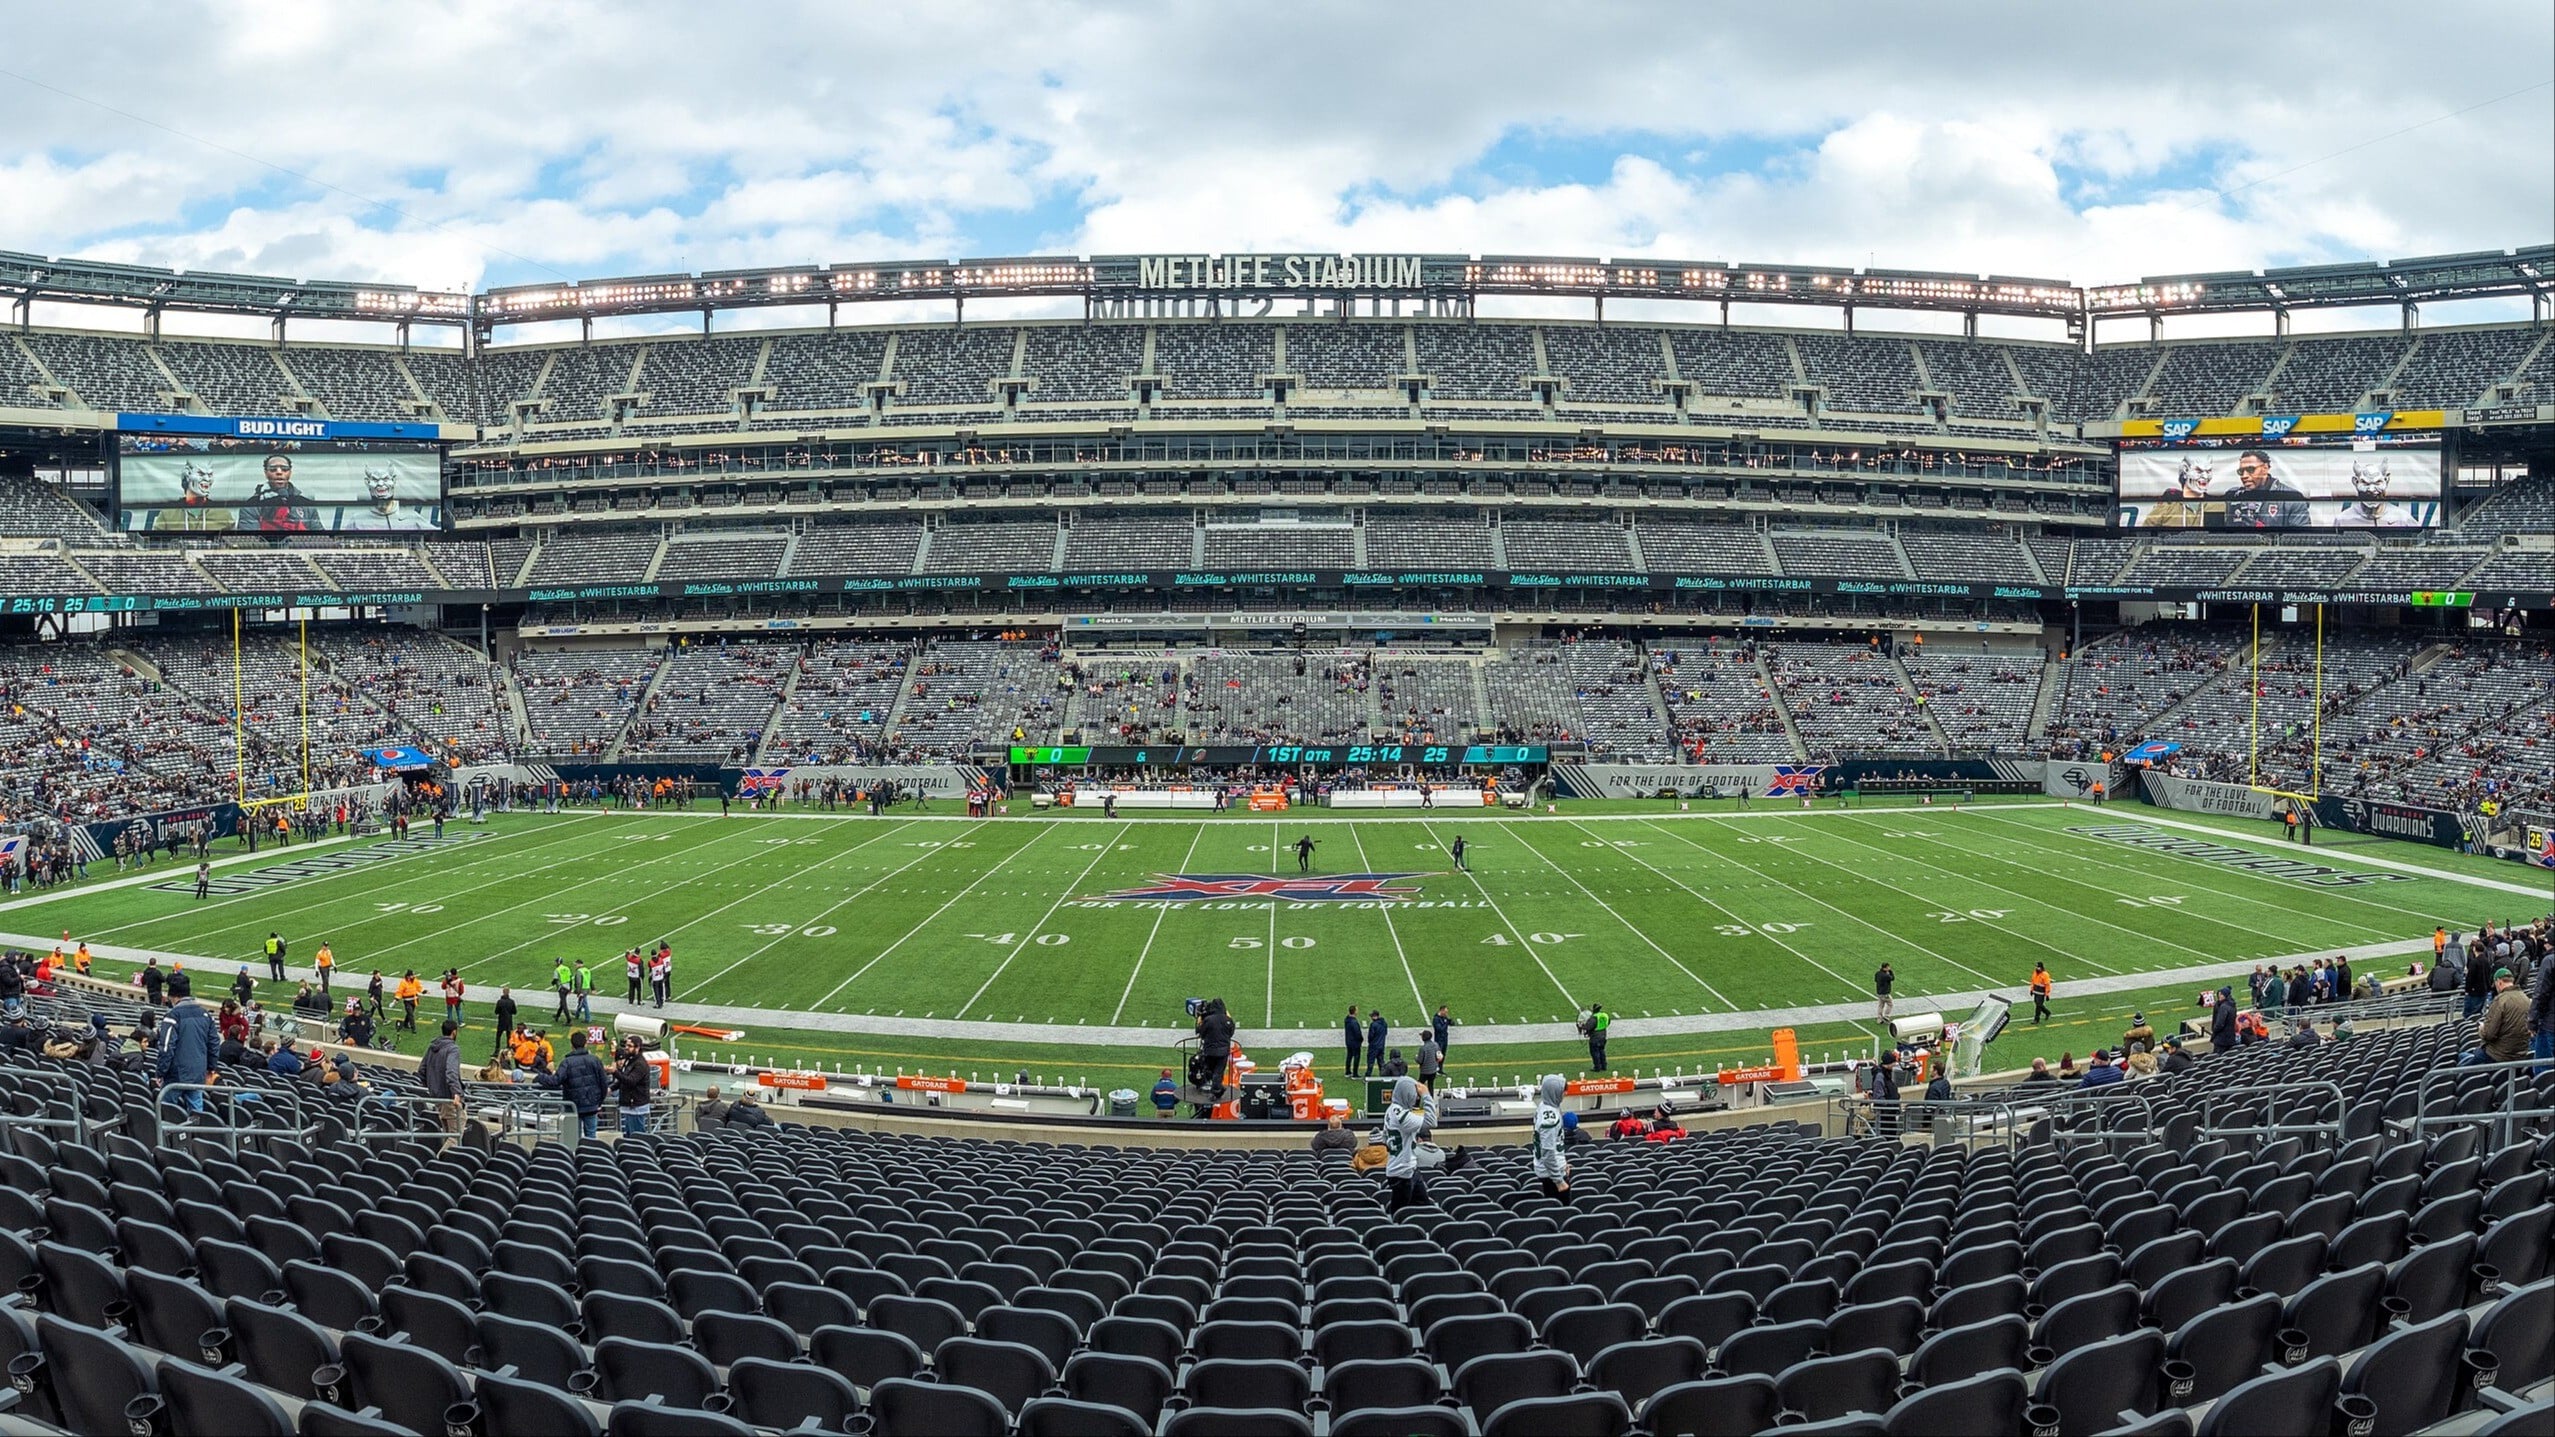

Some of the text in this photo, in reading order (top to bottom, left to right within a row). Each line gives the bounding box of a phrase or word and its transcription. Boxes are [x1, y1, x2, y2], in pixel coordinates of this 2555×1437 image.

[1139, 256, 1422, 288] METLIFE STADIUM
[240, 421, 325, 436] BUD LIGHT
[2163, 423, 2191, 437] SAP
[2262, 420, 2291, 435] SAP
[2355, 417, 2384, 431] SAP
[898, 577, 981, 588] @WHITESTARBAR
[1063, 574, 1148, 585] @WHITESTARBAR
[1230, 573, 1316, 584] @WHITESTARBAR
[1398, 573, 1484, 584] @WHITESTARBAR
[1565, 574, 1648, 586] @WHITESTARBAR
[1729, 578, 1812, 590] @WHITESTARBAR
[580, 586, 659, 598] @WHITESTARBAR
[737, 580, 818, 592] @WHITESTARBAR
[1890, 584, 1970, 595] @WHITESTARBAR
[206, 595, 283, 607] @WHITESTARBAR
[346, 593, 422, 604] @WHITESTARBAR
[2196, 590, 2274, 601] @WHITESTARBAR
[2333, 593, 2411, 604] @WHITESTARBAR
[2445, 592, 2455, 605] 0
[12, 598, 55, 612] 25:16
[64, 598, 83, 611] 25
[125, 597, 136, 609] 0
[2508, 597, 2515, 607] &
[1230, 616, 1327, 624] METLIFE STADIUM
[1050, 748, 1062, 763] 0
[1136, 752, 1147, 762] &
[1268, 747, 1331, 762] 1ST QTR
[1347, 747, 1402, 762] 25:14
[1423, 747, 1448, 762] 25
[1516, 747, 1528, 761] 0
[1610, 776, 1759, 786] FOR THE LOVE OF FOOTBALL
[2185, 785, 2247, 800] FOR THE LOVE
[294, 799, 306, 810] 25
[308, 793, 324, 808] FOR
[2202, 798, 2261, 814] OF FOOTBALL
[2371, 807, 2434, 838] GUARDIANS
[2530, 832, 2542, 847] 25
[1062, 901, 1116, 909] FOR
[1295, 901, 1323, 909] OF
[1339, 901, 1491, 909] FOOTBALL
[547, 914, 629, 926] 20
[1926, 908, 1999, 923] 20
[752, 923, 838, 937] 30
[1713, 922, 1797, 936] 30
[984, 932, 1070, 946] 40
[1228, 936, 1316, 949] 50
[1480, 931, 1564, 946] 40
[589, 1029, 603, 1042] 30
[773, 1077, 810, 1086] GATORADE
[1735, 1071, 1772, 1081] GATORADE
[911, 1079, 948, 1089] GATORADE
[1580, 1083, 1618, 1092] GATORADE
[1293, 1098, 1308, 1119] G
[1543, 1110, 1556, 1120] 33
